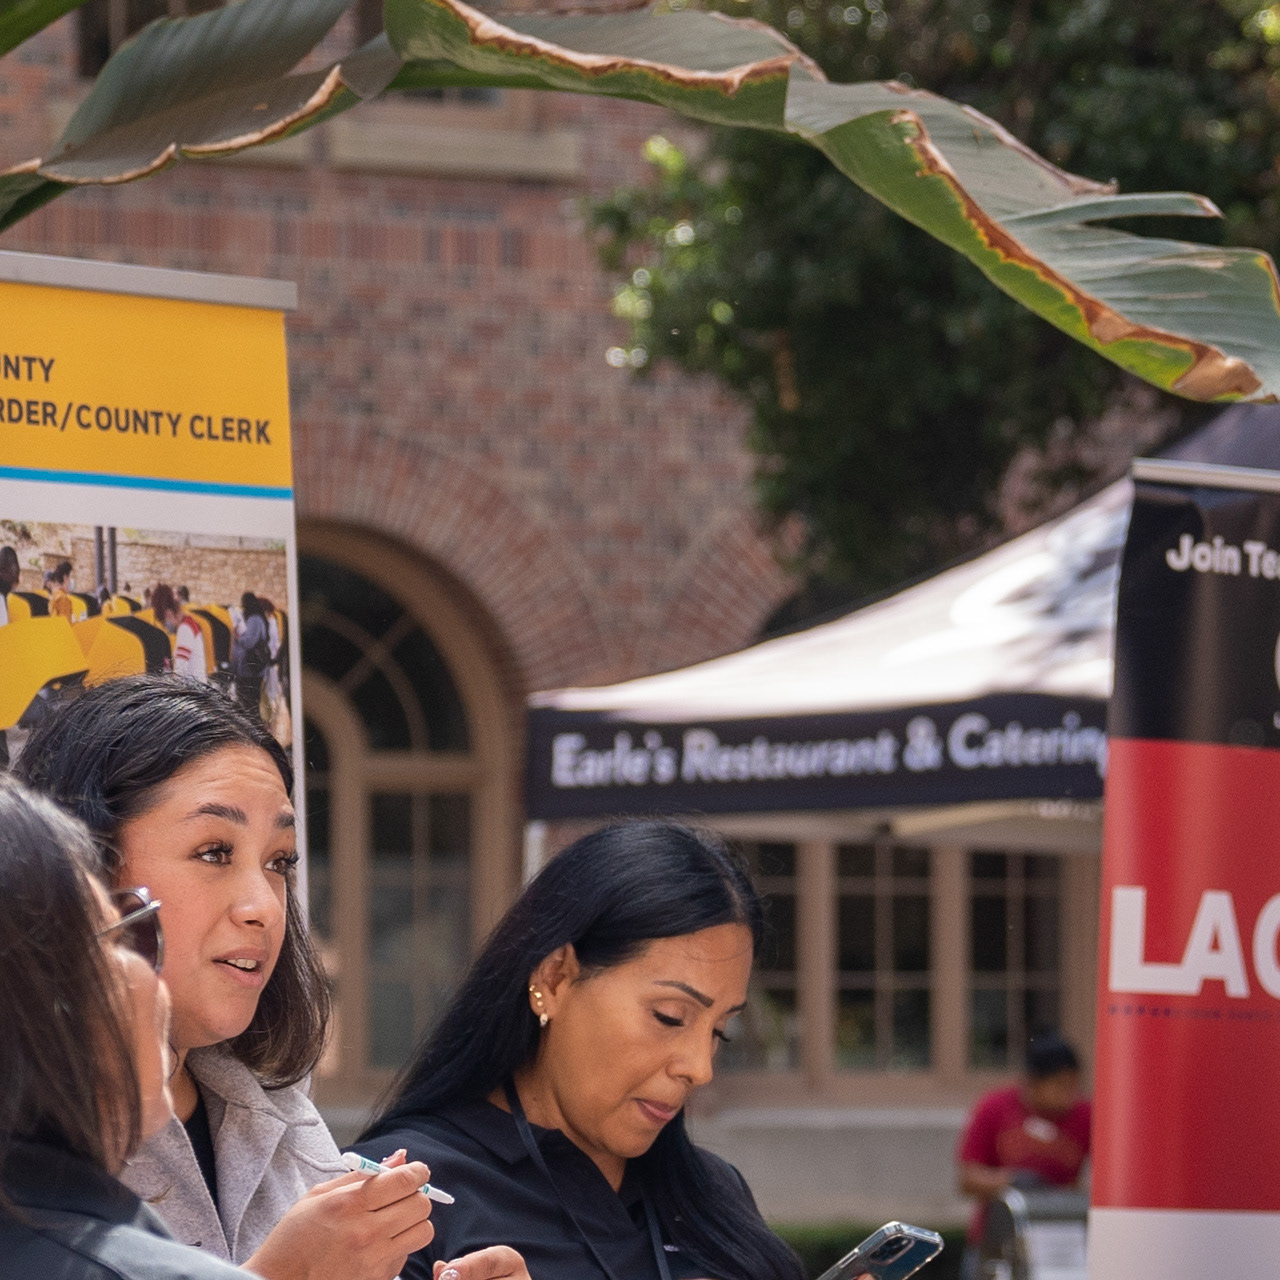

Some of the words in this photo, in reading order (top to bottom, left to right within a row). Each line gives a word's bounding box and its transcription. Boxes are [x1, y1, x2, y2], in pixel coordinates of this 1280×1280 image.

[189, 414, 272, 445] CLERK
[1166, 533, 1241, 575] Join
[550, 729, 676, 789] Earle's
[680, 726, 898, 783] Restaurant
[902, 713, 943, 773] &
